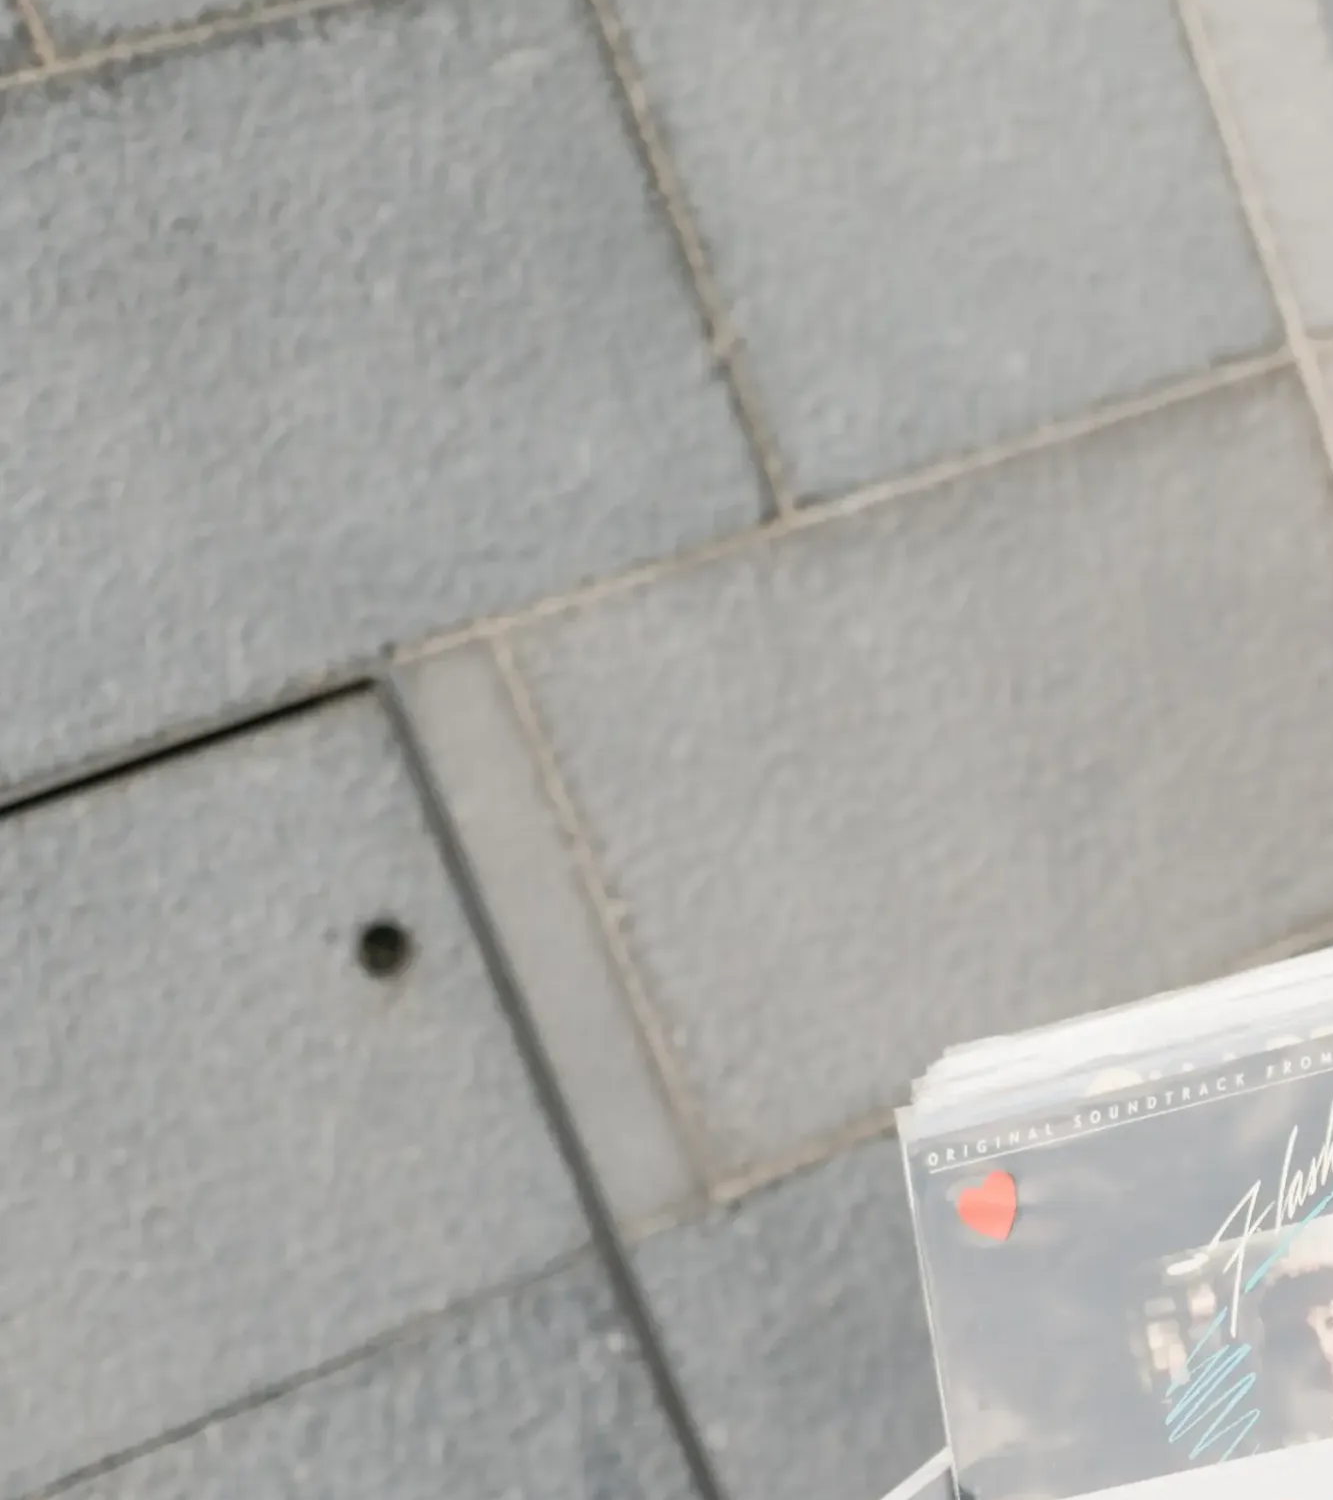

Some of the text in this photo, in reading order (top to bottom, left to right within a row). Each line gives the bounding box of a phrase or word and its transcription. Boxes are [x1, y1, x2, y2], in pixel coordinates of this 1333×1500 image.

[927, 1122, 1054, 1167] ORIGINAL
[1072, 1072, 1246, 1129] SOUNDTRACK
[1265, 1050, 1333, 1077] FROM
